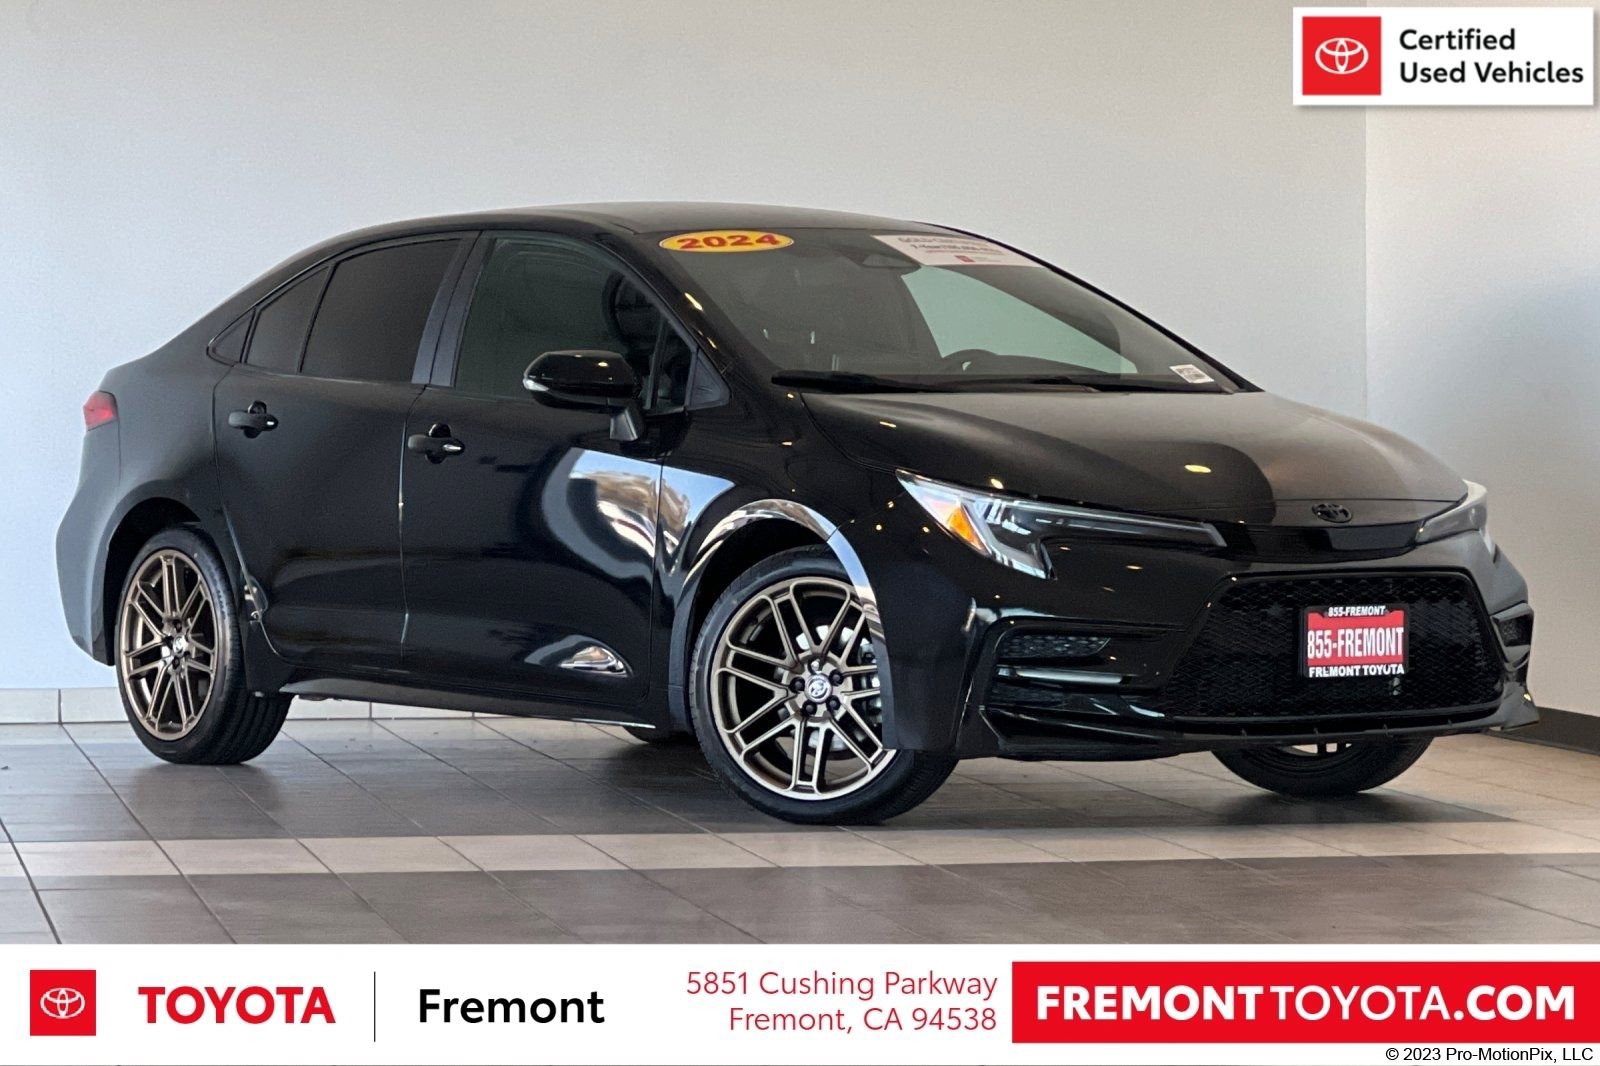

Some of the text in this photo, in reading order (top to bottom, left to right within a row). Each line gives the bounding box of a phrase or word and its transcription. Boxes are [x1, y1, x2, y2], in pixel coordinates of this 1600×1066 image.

[677, 234, 781, 249] 2024
[1328, 605, 1386, 617] 855-FREMONT
[1307, 627, 1404, 659] 855-FREMONT
[1309, 664, 1405, 678] FREMONT TOYOTA
